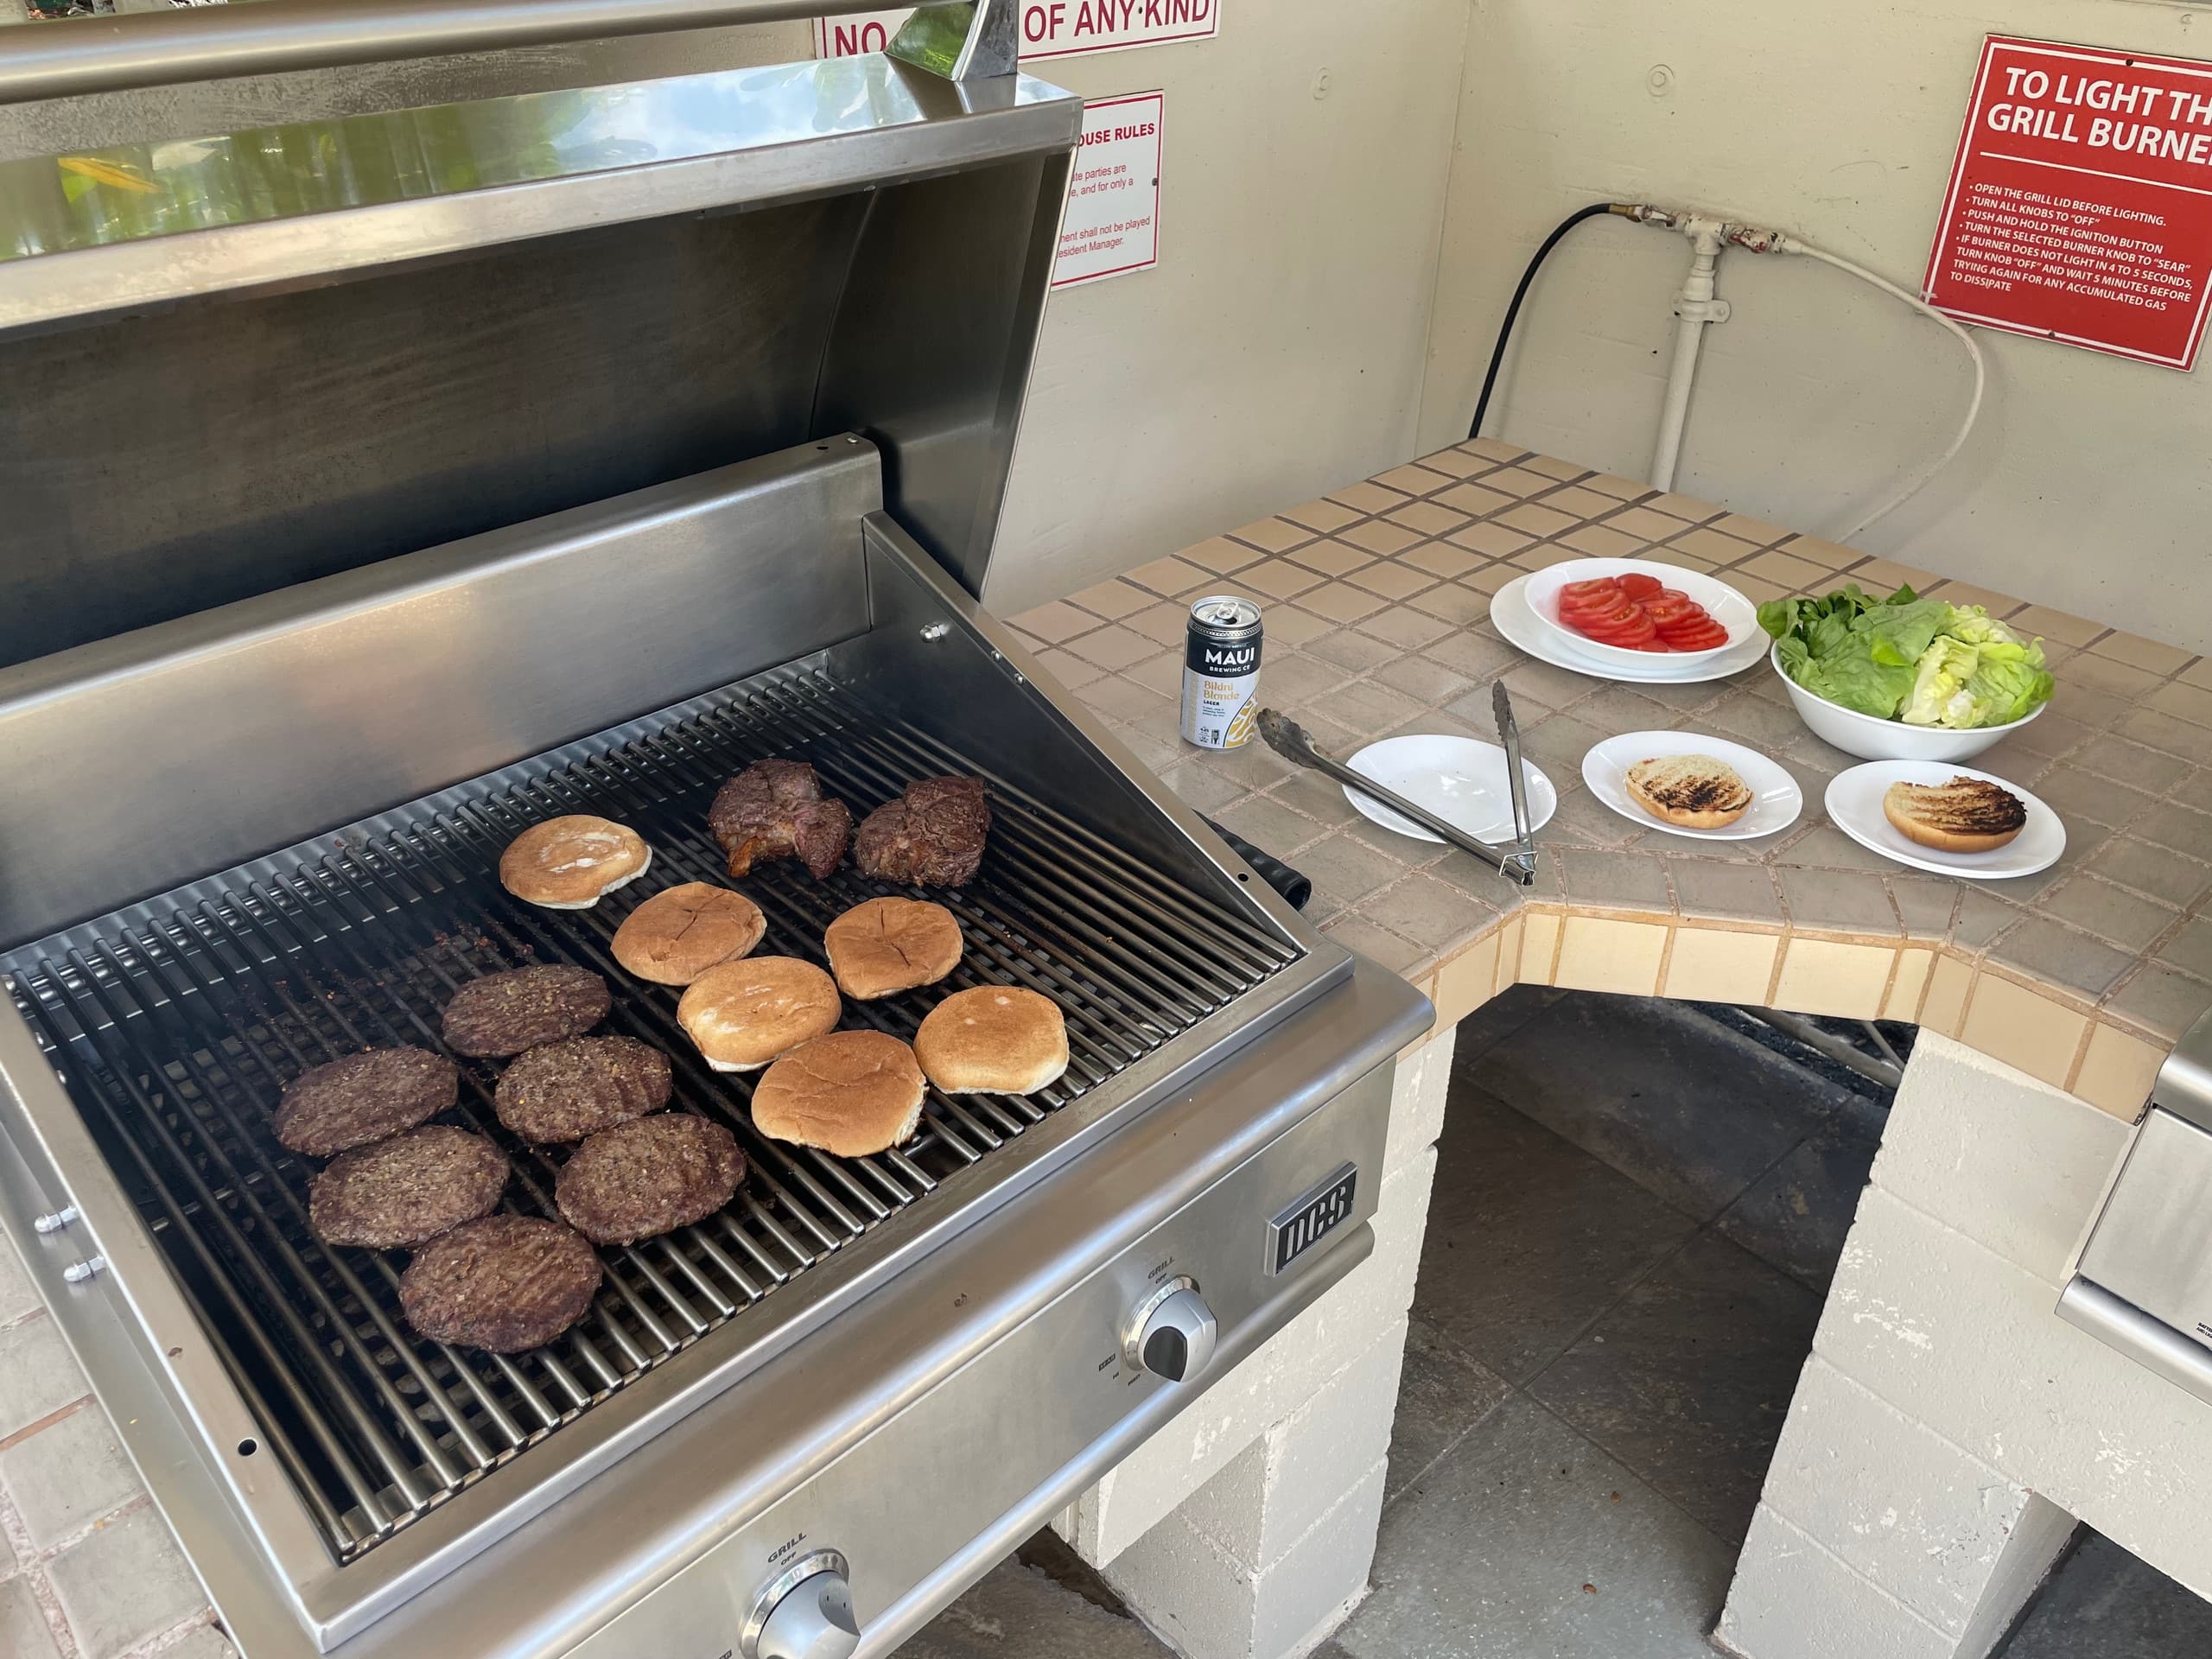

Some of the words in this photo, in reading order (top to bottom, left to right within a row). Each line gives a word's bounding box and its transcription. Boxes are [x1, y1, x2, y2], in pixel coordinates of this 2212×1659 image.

[835, 22, 887, 56] NO
[1024, 3, 1065, 42] OF
[1074, 0, 1135, 37] ANY
[1145, 0, 1210, 29] KIND
[2005, 67, 2050, 99] TO
[2055, 75, 2164, 117] LIGHT
[1115, 123, 1155, 141] RULES
[1987, 103, 2079, 143] GRILL
[2088, 118, 2212, 166] BURNE
[1081, 184, 1096, 195] and
[1098, 181, 1109, 192] for
[1110, 178, 1127, 190] only
[1085, 167, 1112, 182] parties
[1114, 164, 1127, 175] are
[1972, 196, 1999, 209] TURN
[1999, 201, 2017, 213] ALL
[2018, 205, 2055, 219] KNOBS
[2056, 211, 2069, 221] TO
[1975, 183, 2002, 195] OPEN
[2005, 188, 2023, 200] THE
[2024, 192, 2052, 205] GRILL
[2054, 197, 2071, 207] LID
[2072, 200, 2113, 216] BEFORE
[2113, 207, 2166, 226] LIGHTING.
[1080, 227, 1098, 239] shall
[1100, 225, 1112, 235] not
[1114, 221, 1123, 232] be
[1125, 216, 1151, 233] played
[1967, 209, 1995, 222] PUSH
[1996, 214, 2018, 226] AND
[2019, 219, 2049, 232] HOLD
[2050, 224, 2069, 236] THE
[2070, 228, 2119, 245] IGNITION
[2120, 238, 2164, 254] BUTTON
[1058, 244, 1088, 258] esident
[1965, 221, 1991, 234] TURN
[1993, 226, 2012, 238] THE
[2012, 231, 2062, 248] SELECTED
[2063, 241, 2105, 257] BURNER
[2106, 249, 2136, 263] KNOB
[2138, 255, 2152, 266] TO
[1956, 246, 1983, 259] TURN
[1984, 251, 2012, 265] KNOB
[2042, 264, 2064, 276] AND
[2066, 268, 2094, 282] WAIT
[2093, 274, 2101, 283] 5
[2101, 276, 2149, 293] MINUTES
[2150, 286, 2192, 302] BEFORE
[1961, 234, 1970, 243] IF
[1972, 236, 2011, 251] BURNER
[2012, 245, 2039, 257] DOES
[2040, 250, 2063, 261] NOT
[2063, 254, 2094, 268] LIGHT
[2095, 260, 2107, 270] IN
[2108, 264, 2115, 272] 4
[2117, 264, 2131, 276] TO
[2133, 269, 2140, 277] 5
[2142, 270, 2192, 289] SECONDS,
[1950, 271, 1962, 281] TO
[1964, 274, 2012, 291] DISSIPATE
[1954, 258, 1988, 274] TRYING
[1989, 266, 2021, 280] AGAIN
[2022, 273, 2043, 284] FOR
[2044, 277, 2066, 289] ANY
[2066, 283, 2144, 306] ACCUMULATED
[2145, 299, 2167, 311] GAS
[1205, 646, 1255, 664] MAUI
[1204, 690, 1240, 700] Blonde
[1286, 1186, 1346, 1261] DCS
[1148, 1256, 1175, 1279] GRILL
[767, 1532, 807, 1563] GRILL
[781, 1552, 797, 1566] OFF
